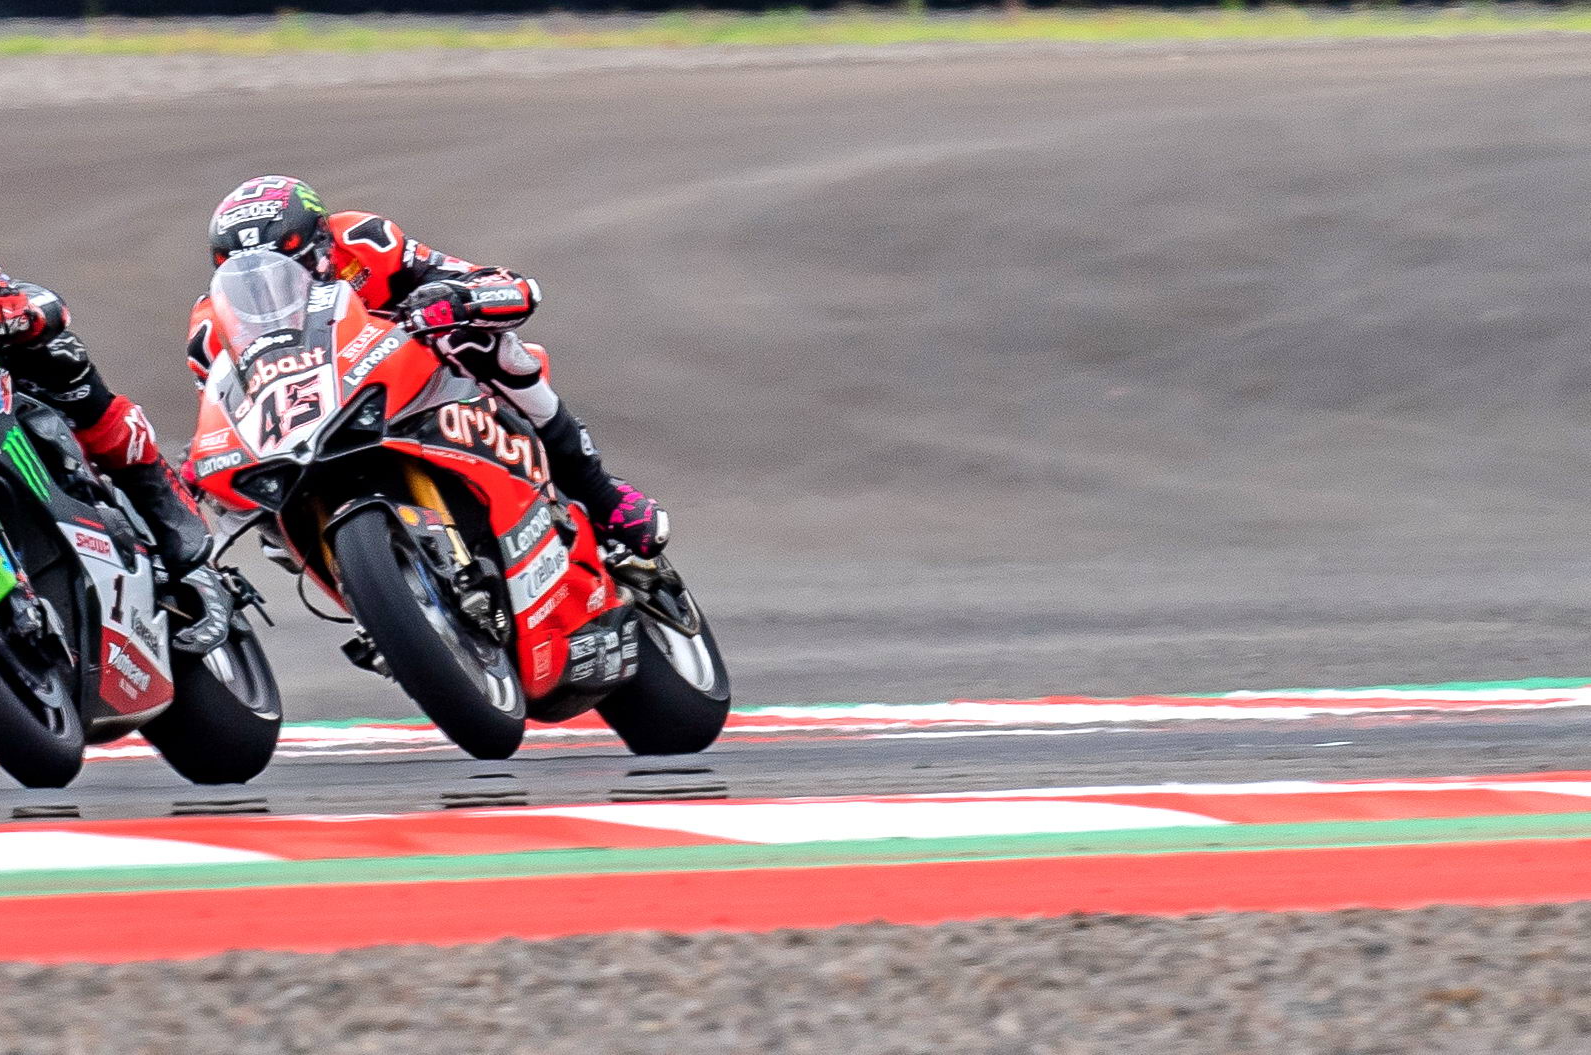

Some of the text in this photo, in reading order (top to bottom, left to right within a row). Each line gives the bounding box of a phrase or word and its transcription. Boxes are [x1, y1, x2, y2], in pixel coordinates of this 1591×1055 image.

[343, 336, 401, 387] Lenovo
[259, 371, 325, 455] 45
[505, 506, 552, 560] Lenovo
[110, 574, 124, 624] 1
